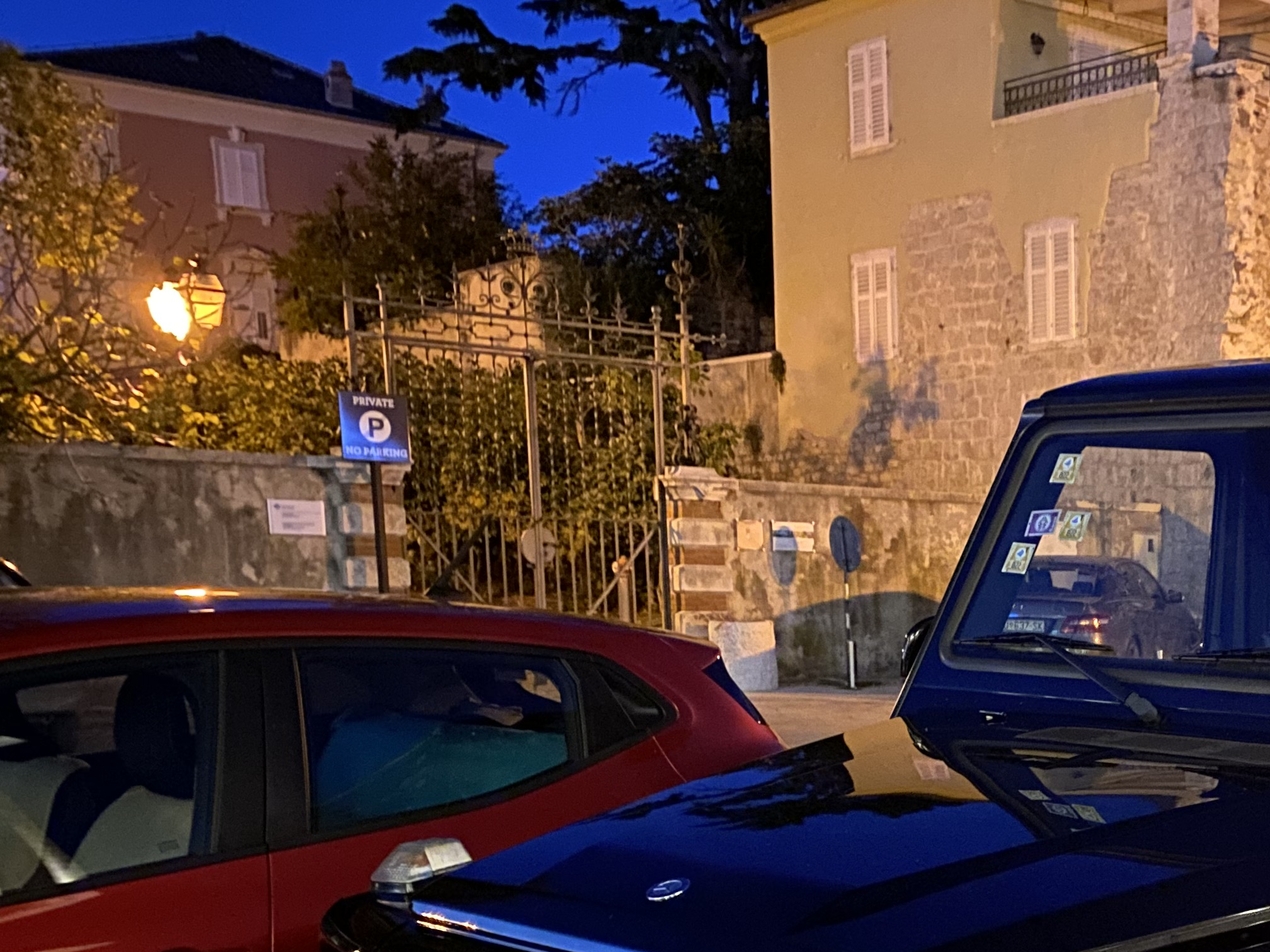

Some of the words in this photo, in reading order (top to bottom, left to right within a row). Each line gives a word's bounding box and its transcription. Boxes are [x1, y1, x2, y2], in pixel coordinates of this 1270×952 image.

[352, 396, 395, 409] PRIVATE
[368, 417, 384, 438] P
[345, 445, 361, 456] NO
[363, 446, 408, 459] PARKING
